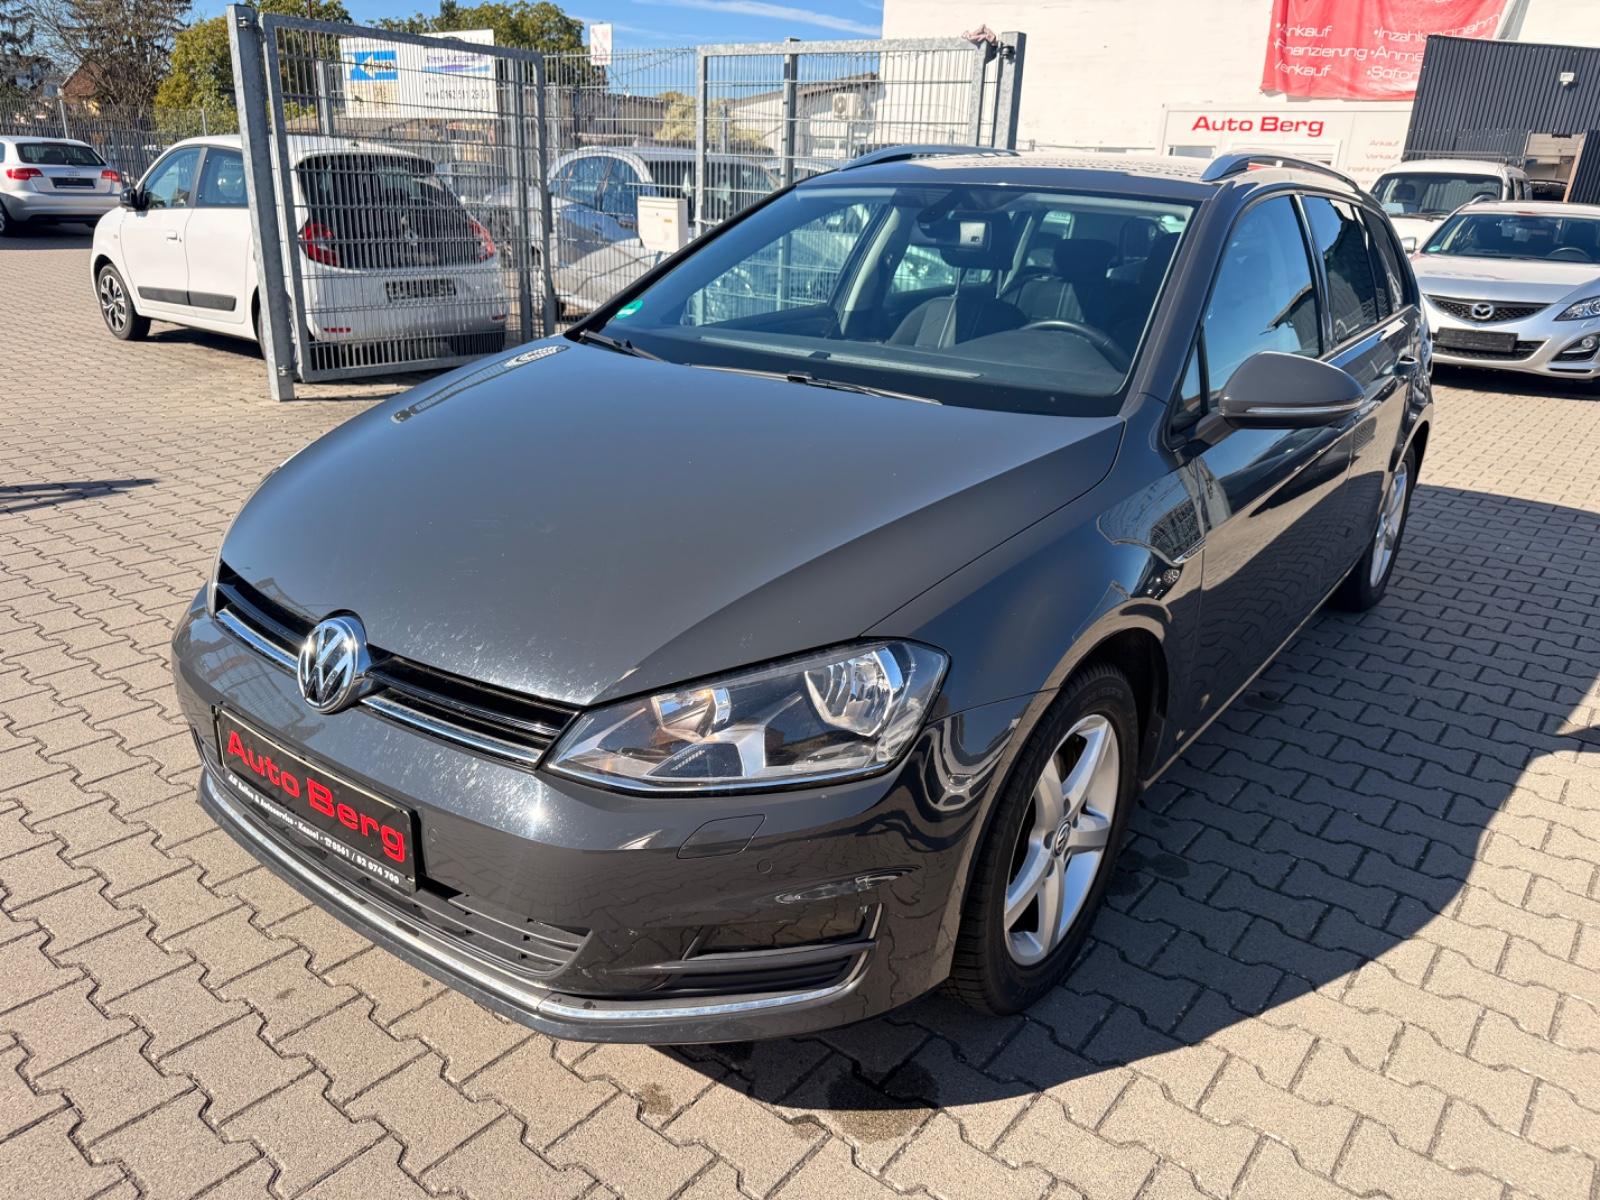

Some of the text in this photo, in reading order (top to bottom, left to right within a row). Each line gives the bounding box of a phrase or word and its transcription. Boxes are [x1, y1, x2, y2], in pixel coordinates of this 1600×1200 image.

[1274, 38, 1368, 61] Fnanzierung
[1374, 46, 1424, 61] Anme
[1191, 116, 1325, 138] Auto Berg
[226, 730, 406, 864] Auto Berg
